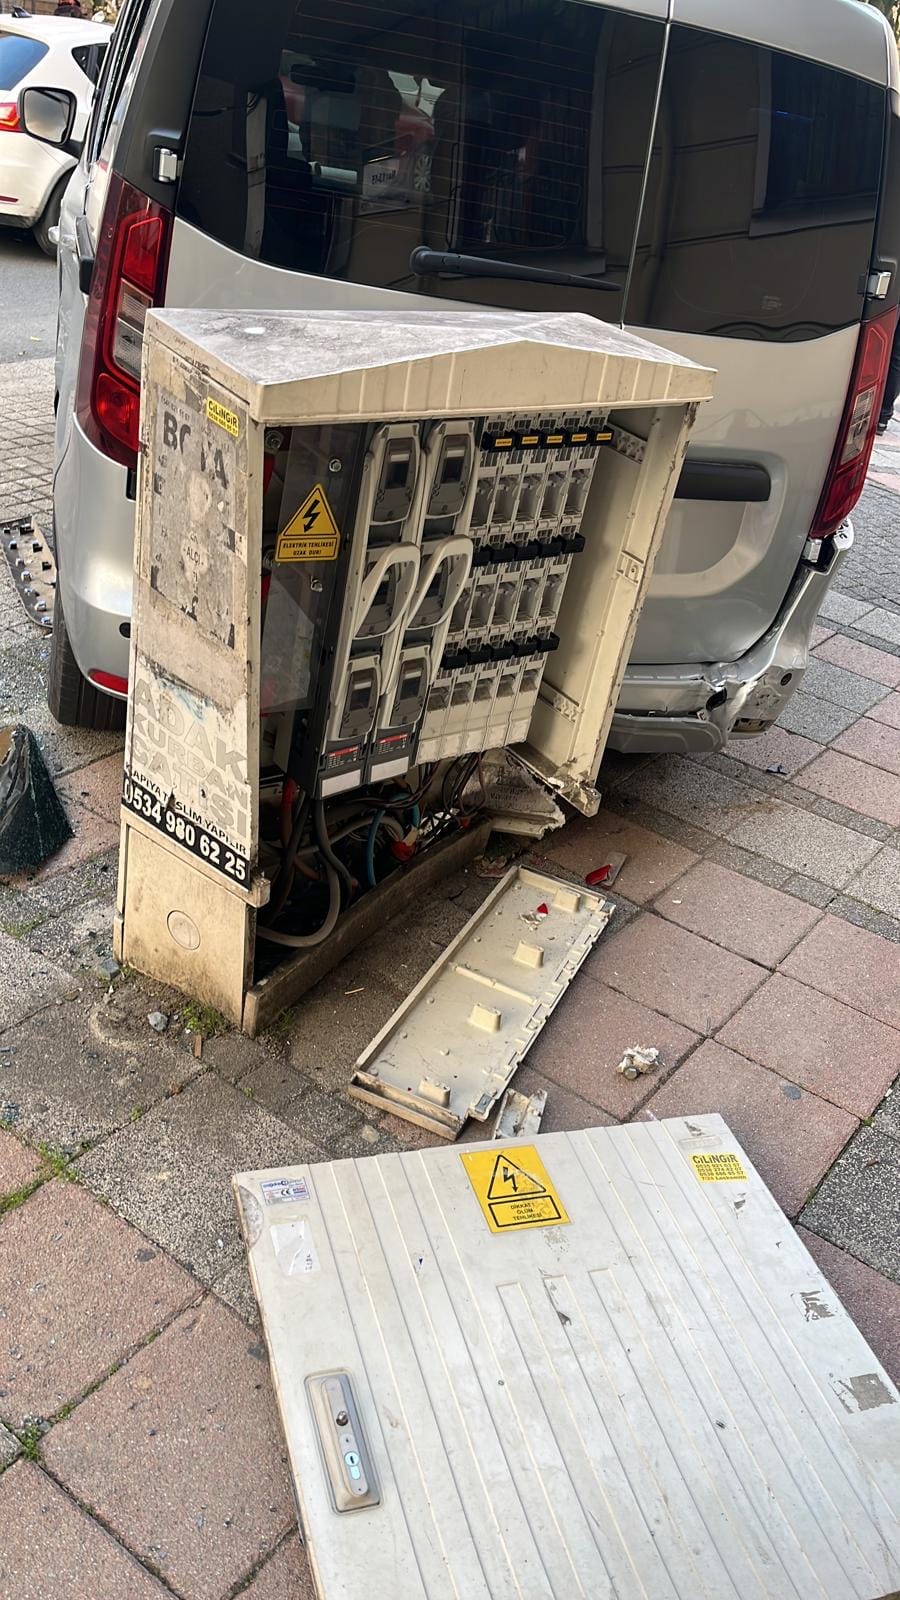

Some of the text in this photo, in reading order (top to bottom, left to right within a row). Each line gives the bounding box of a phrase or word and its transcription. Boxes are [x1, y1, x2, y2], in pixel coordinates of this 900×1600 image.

[128, 704, 247, 811] KURBAN
[130, 678, 247, 784] ADAK
[123, 778, 247, 881] 0534 980 62 25
